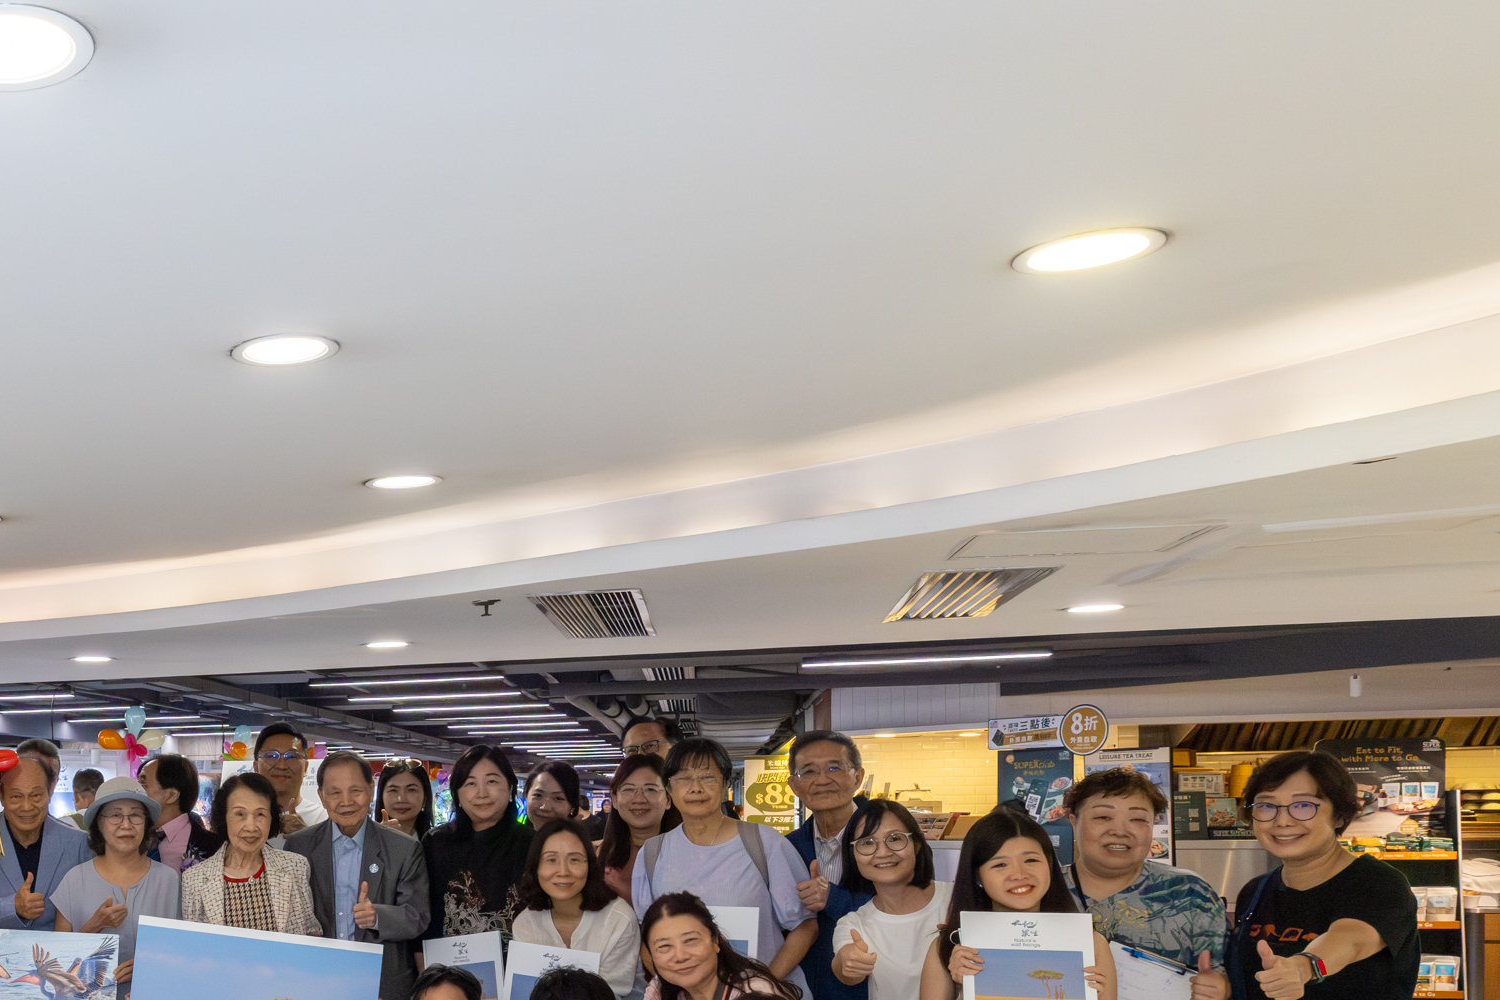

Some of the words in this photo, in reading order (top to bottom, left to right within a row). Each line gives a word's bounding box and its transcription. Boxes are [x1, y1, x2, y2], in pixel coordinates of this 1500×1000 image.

[1019, 717, 1051, 731] 三點後
[1071, 712, 1099, 735] 8折
[1070, 735, 1098, 743] 外賣自取
[1387, 746, 1404, 755] Fit,
[1341, 755, 1362, 763] with
